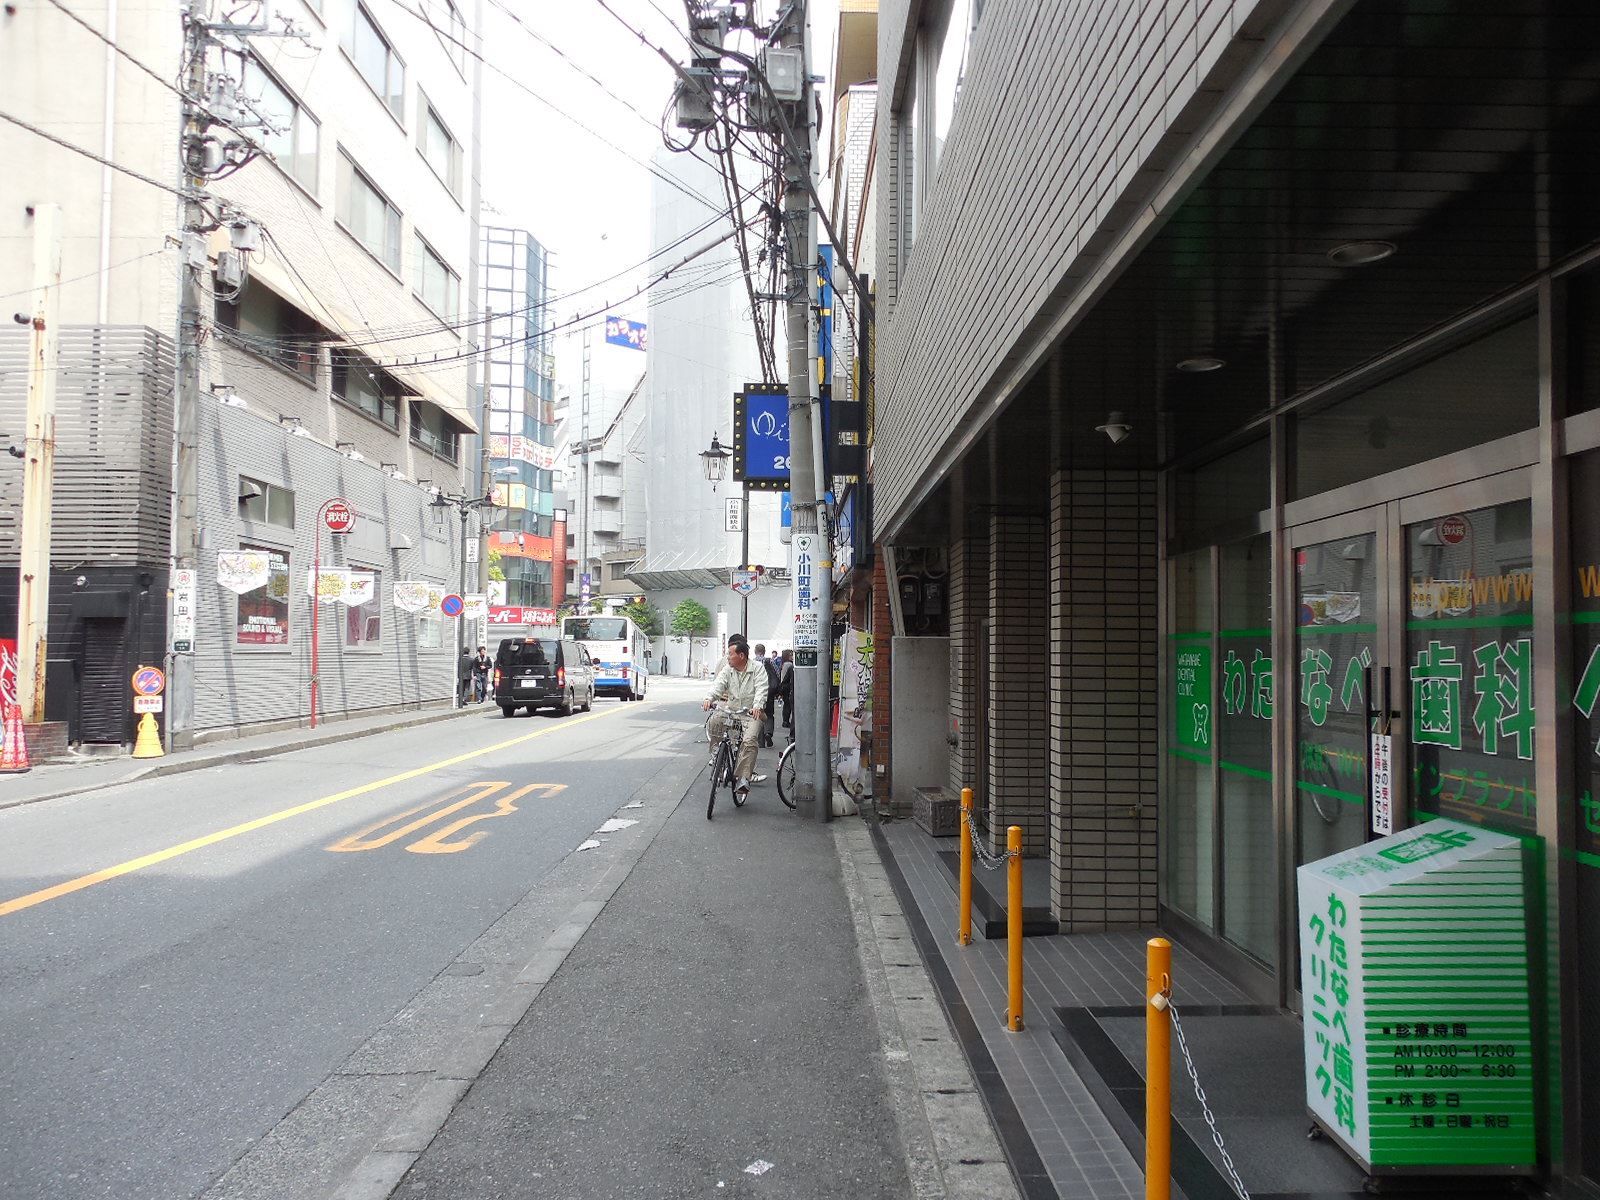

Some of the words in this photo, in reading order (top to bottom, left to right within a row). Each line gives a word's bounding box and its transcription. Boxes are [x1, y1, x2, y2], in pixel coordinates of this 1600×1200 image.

[326, 511, 349, 523] 消火栓
[797, 552, 811, 610] 小川町歯科
[1177, 668, 1196, 682] DENTAL
[1178, 683, 1194, 697] CLINIC
[1309, 912, 1332, 1099] クリニック
[1327, 891, 1356, 1138] わたなべ歯科
[1395, 1023, 1468, 1039] 診療時間
[1394, 1064, 1415, 1078] PM
[1481, 1064, 1516, 1078] 6:30
[1399, 1092, 1461, 1108] 休診日
